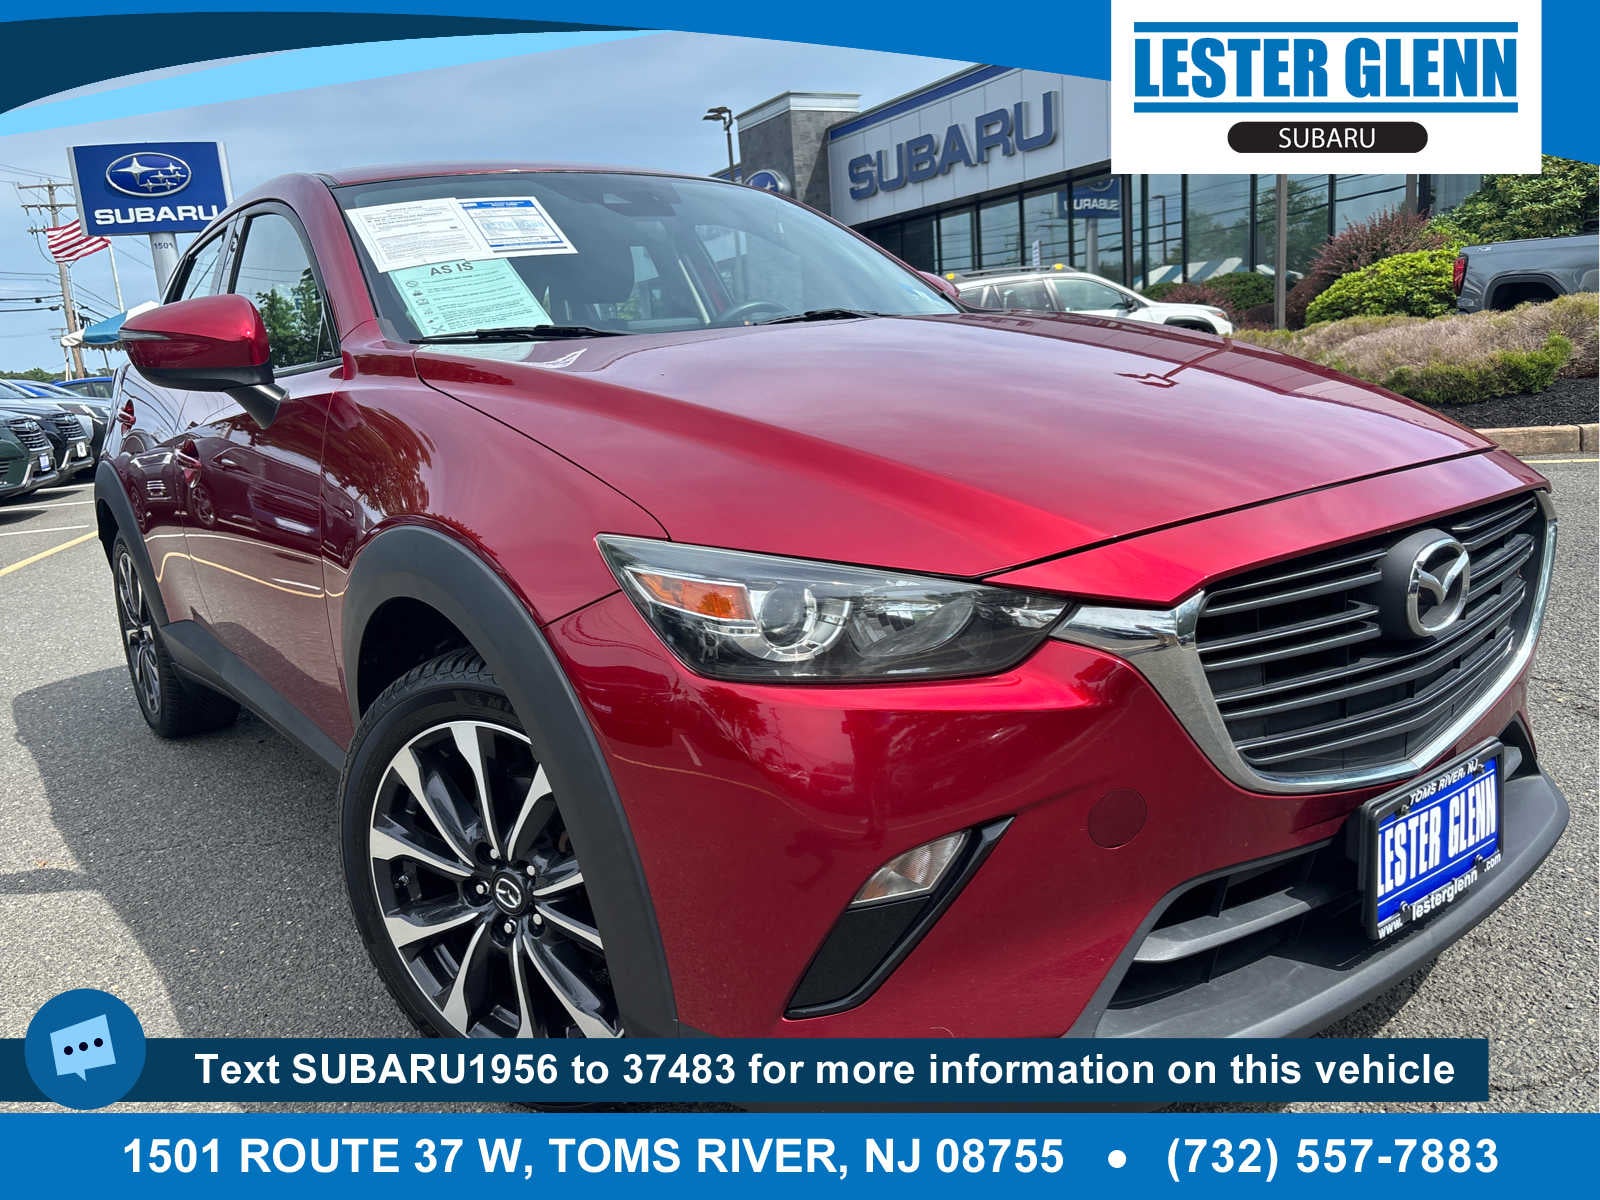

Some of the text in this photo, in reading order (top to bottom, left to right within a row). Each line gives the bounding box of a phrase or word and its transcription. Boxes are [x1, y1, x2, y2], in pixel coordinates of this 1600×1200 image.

[848, 90, 1059, 201] SUBARU
[94, 204, 218, 225] SUBARU
[153, 241, 173, 250] 1501
[430, 261, 474, 277] AS IS
[1409, 783, 1437, 804] TOMS
[1467, 758, 1479, 774] NJ
[1377, 773, 1497, 898] LESTER GLENN
[1411, 869, 1478, 921] lesterglenn
